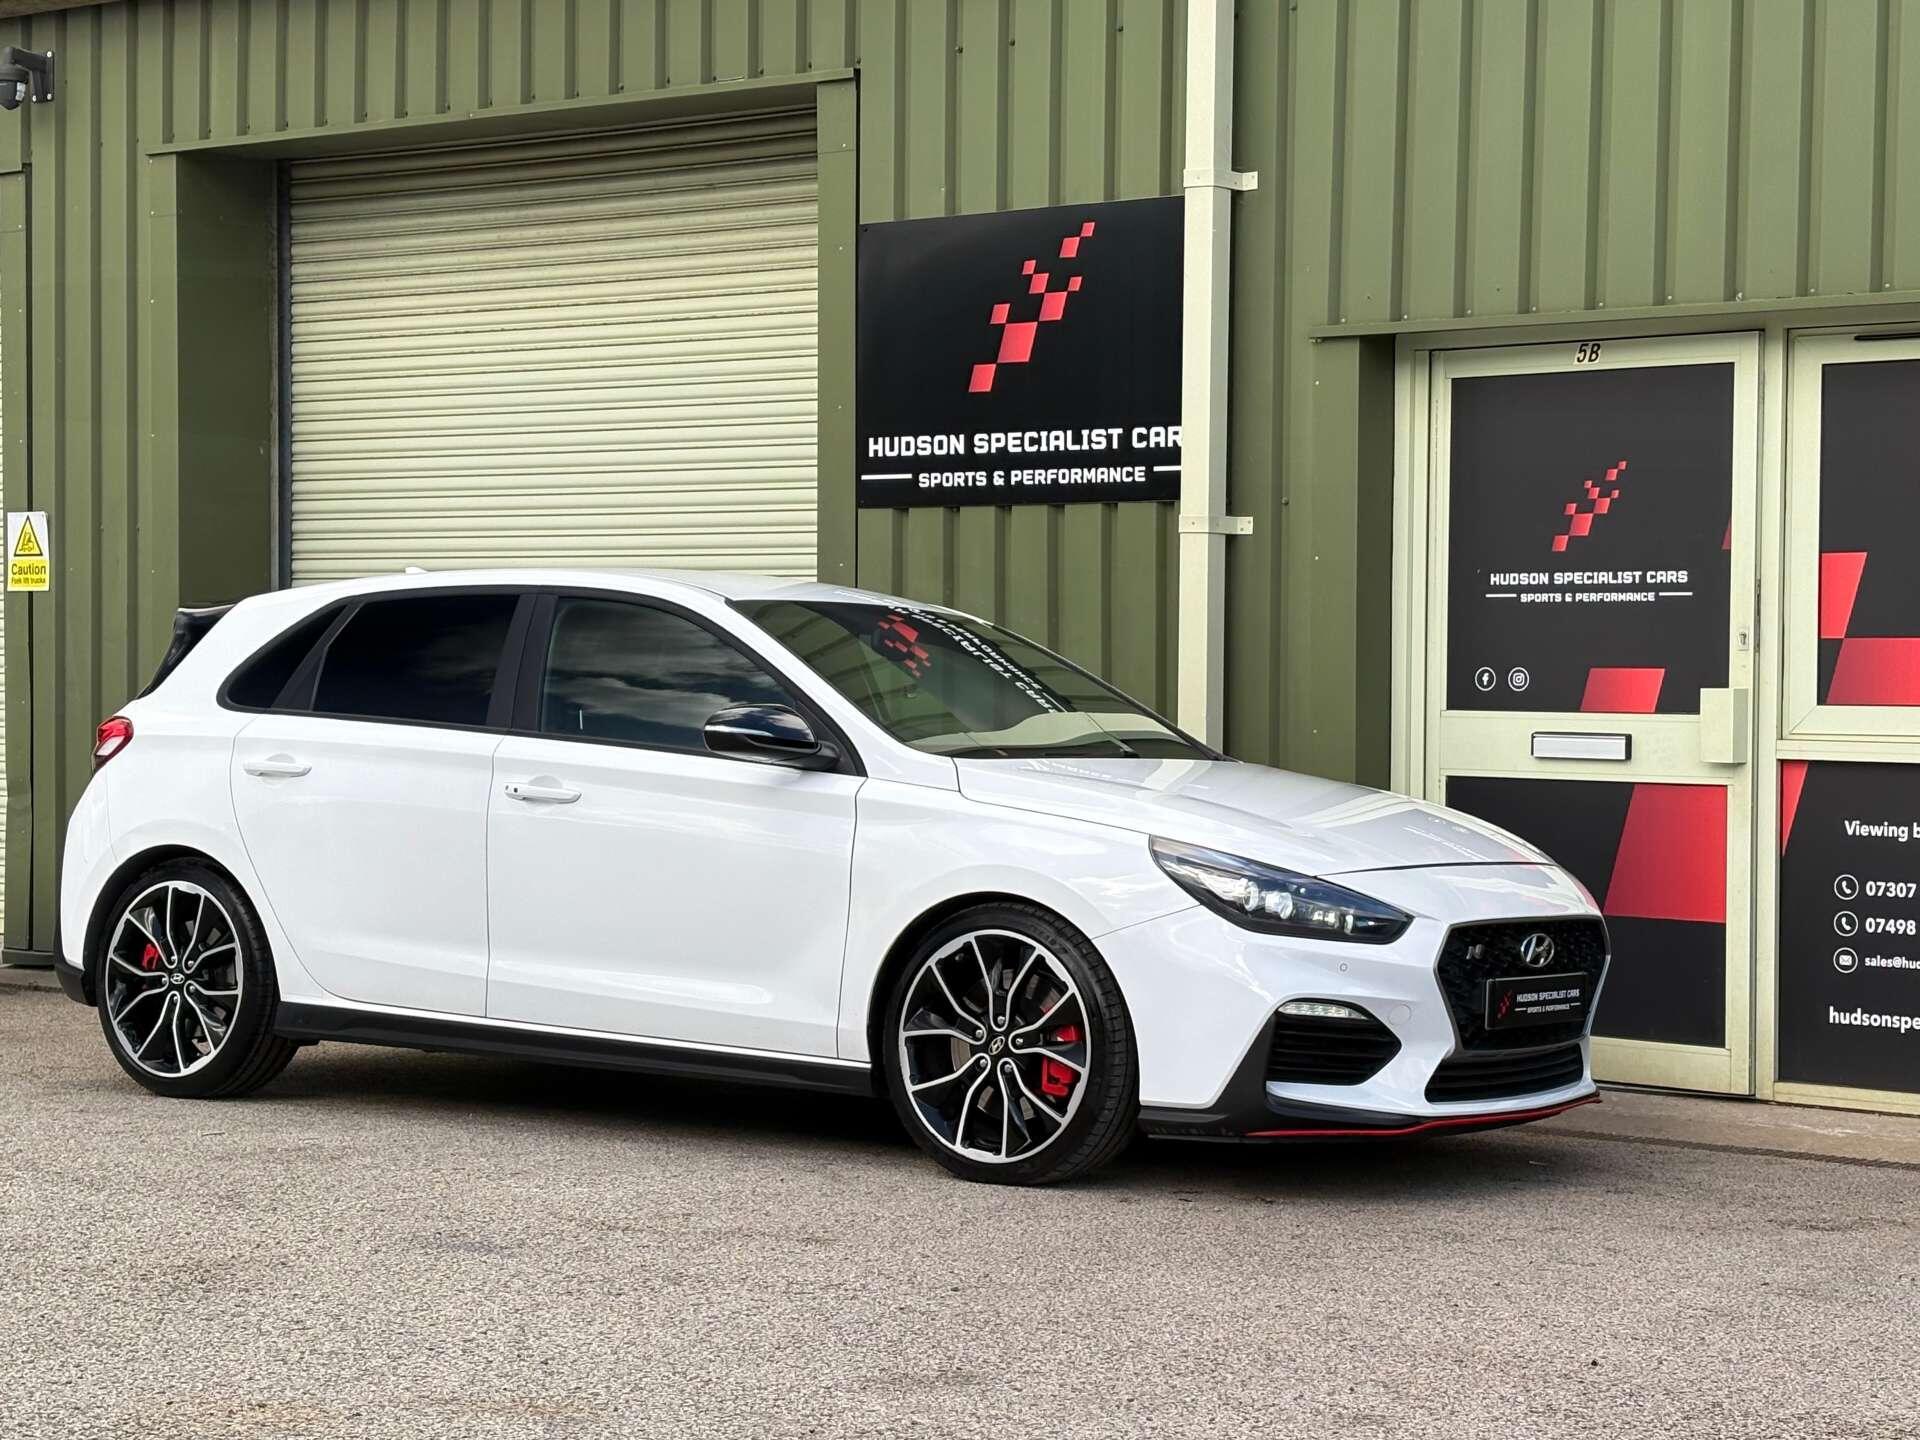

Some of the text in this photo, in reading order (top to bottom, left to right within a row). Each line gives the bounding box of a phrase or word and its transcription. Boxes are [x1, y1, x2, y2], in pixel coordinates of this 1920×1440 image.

[1577, 343, 1601, 363] 5B
[868, 433, 965, 458] HUDSON
[973, 427, 1124, 455] SPECIALIST
[918, 465, 1146, 488] SPORTS & PERFORMANCE
[11, 563, 46, 576] Caution
[1490, 570, 1689, 586] HUDSON SPECIALIST CARS
[1520, 591, 1656, 603] SPORTS & PERFORMANCE
[1844, 820, 1909, 842] Viewing
[1865, 881, 1917, 899] 07307
[1865, 917, 1917, 936] 07498
[1828, 1005, 1920, 1034] hudsonspe
